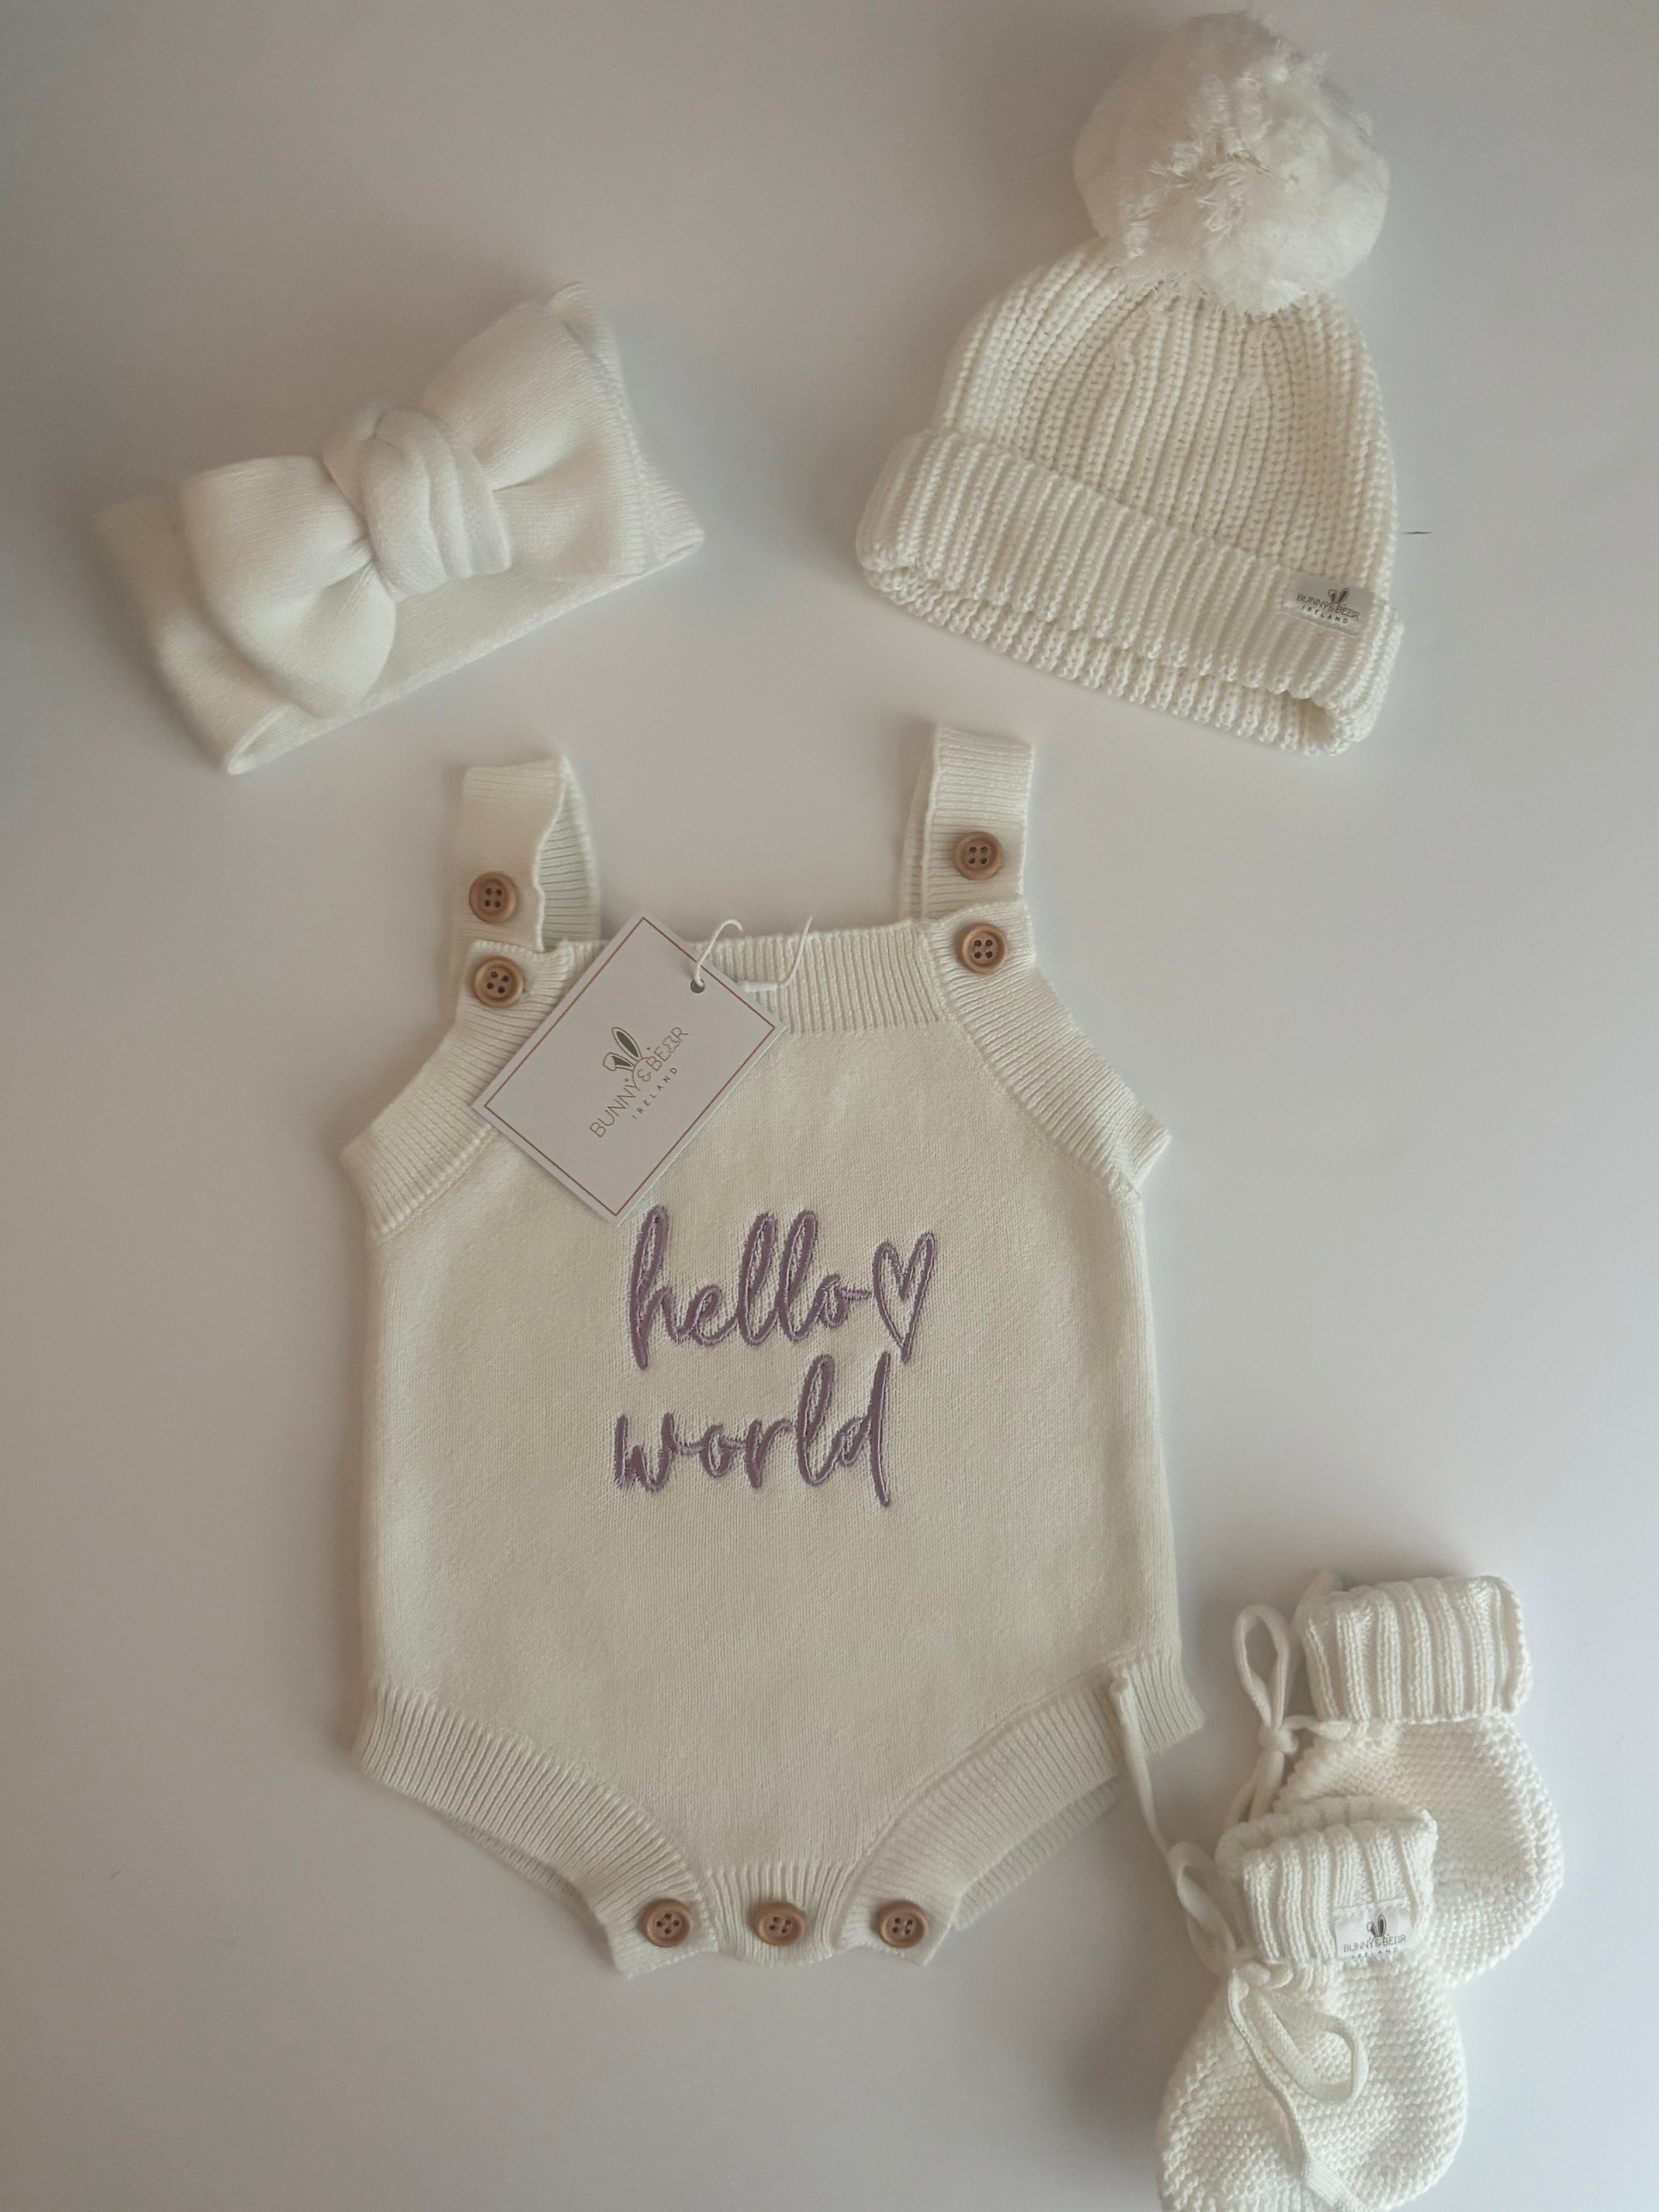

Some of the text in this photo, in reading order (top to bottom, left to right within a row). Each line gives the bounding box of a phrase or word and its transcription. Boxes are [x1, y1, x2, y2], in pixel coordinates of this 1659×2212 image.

[1302, 605, 1348, 624] IRELAND
[632, 1068, 677, 1119] IRELAND
[629, 1205, 872, 1370] hello
[614, 1351, 891, 1507] world
